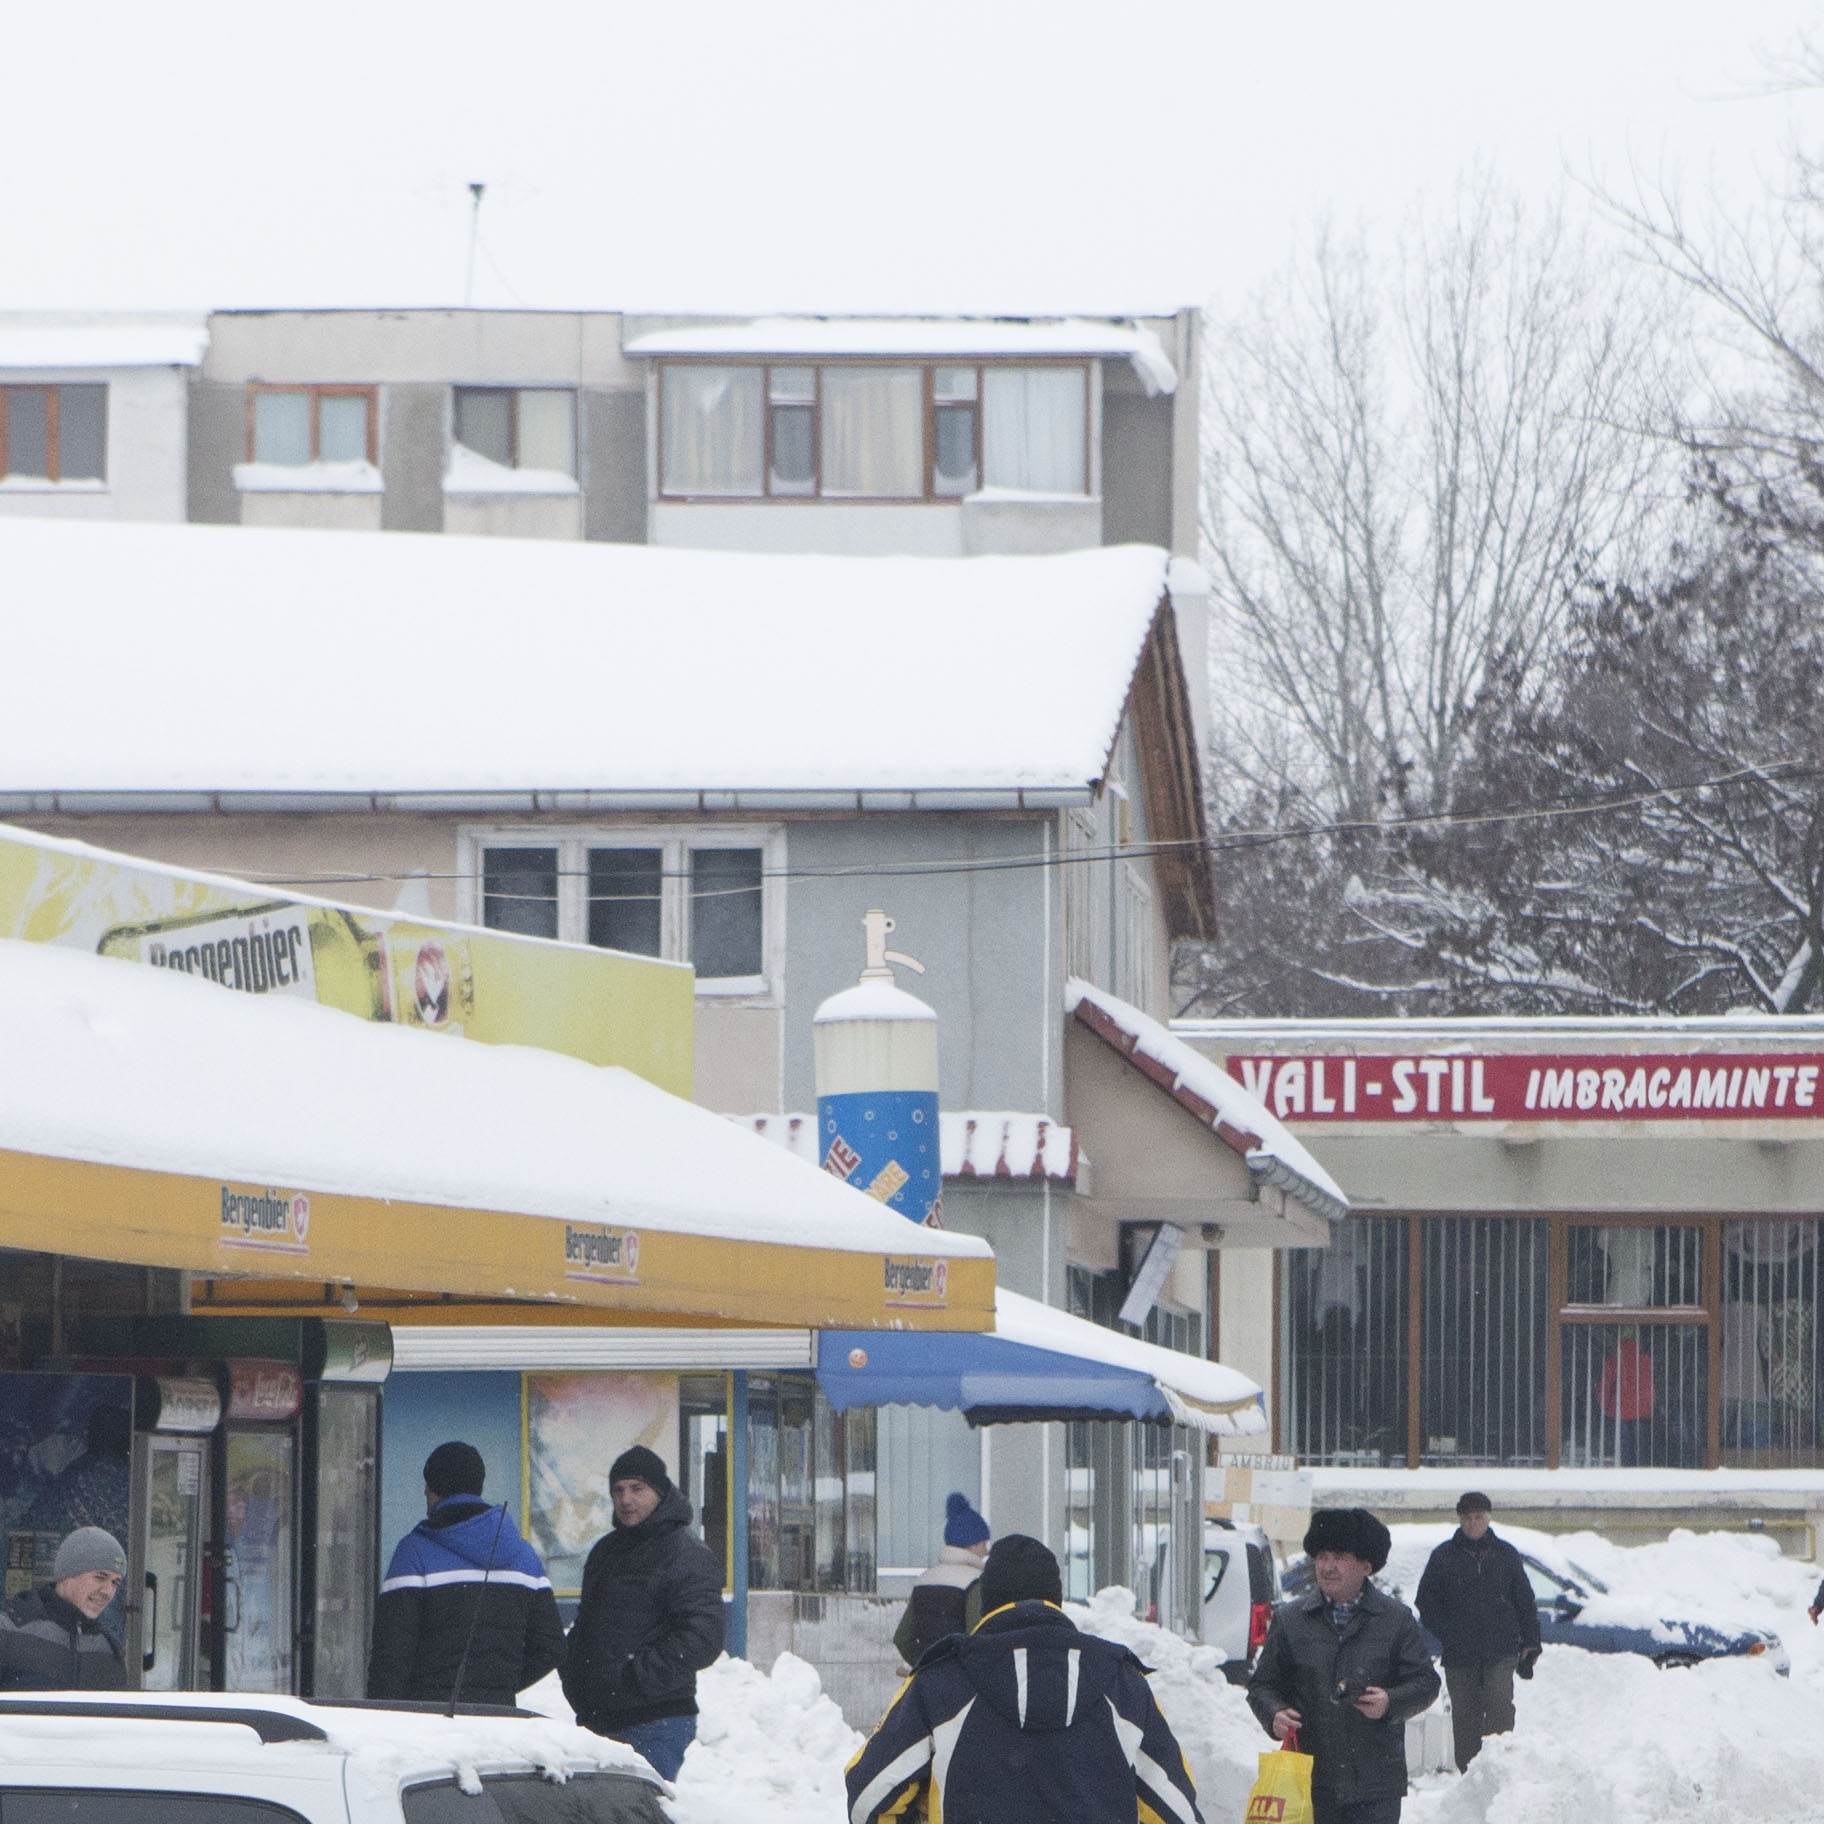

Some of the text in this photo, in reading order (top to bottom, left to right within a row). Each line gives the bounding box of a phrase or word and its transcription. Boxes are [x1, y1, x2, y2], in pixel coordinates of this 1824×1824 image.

[1241, 1059, 1495, 1118] VALI-STIL
[1525, 1066, 1818, 1112] IMBRACAMINTE
[222, 1186, 289, 1233] Bergenbier
